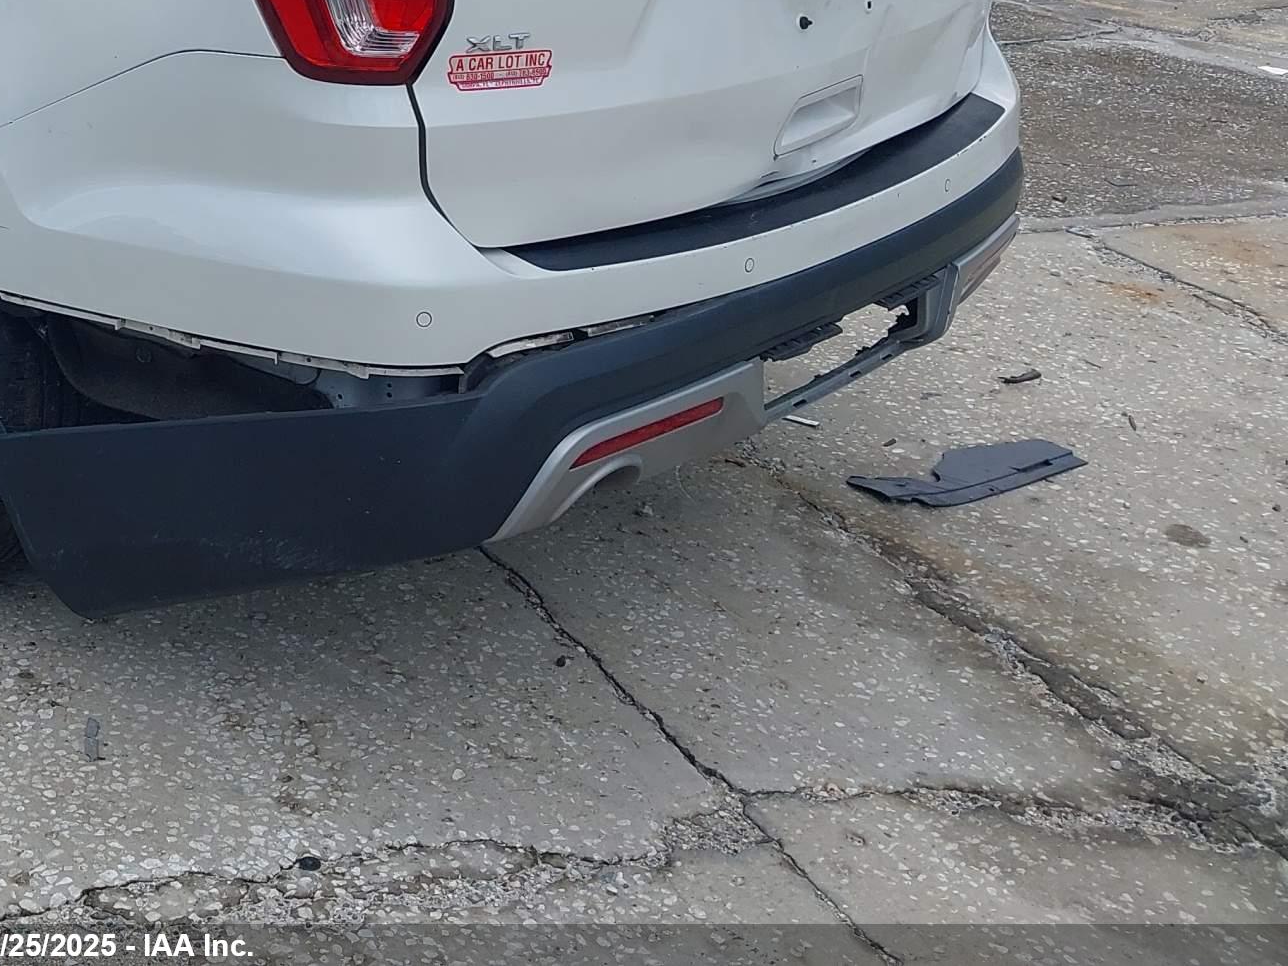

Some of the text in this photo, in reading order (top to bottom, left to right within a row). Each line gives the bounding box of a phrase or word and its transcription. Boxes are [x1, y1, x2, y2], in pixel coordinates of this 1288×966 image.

[466, 33, 530, 53] XLT
[456, 53, 545, 71] A CAR LOT INC
